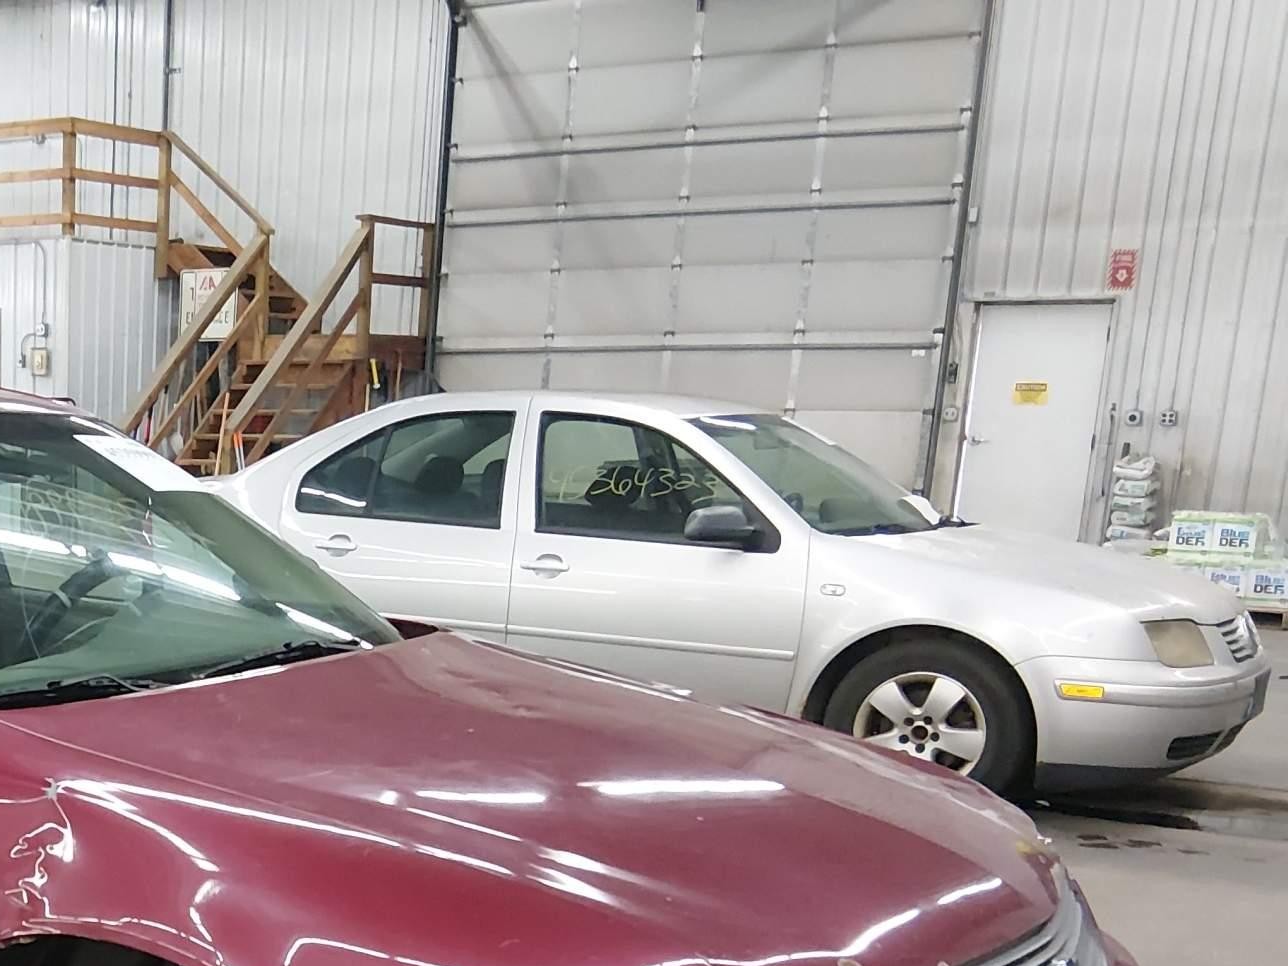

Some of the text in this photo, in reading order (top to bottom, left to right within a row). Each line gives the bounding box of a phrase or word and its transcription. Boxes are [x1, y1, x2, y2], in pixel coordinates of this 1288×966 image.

[1175, 536, 1206, 547] DEF
[1219, 537, 1250, 548] DEF
[1252, 583, 1286, 595] DEF
